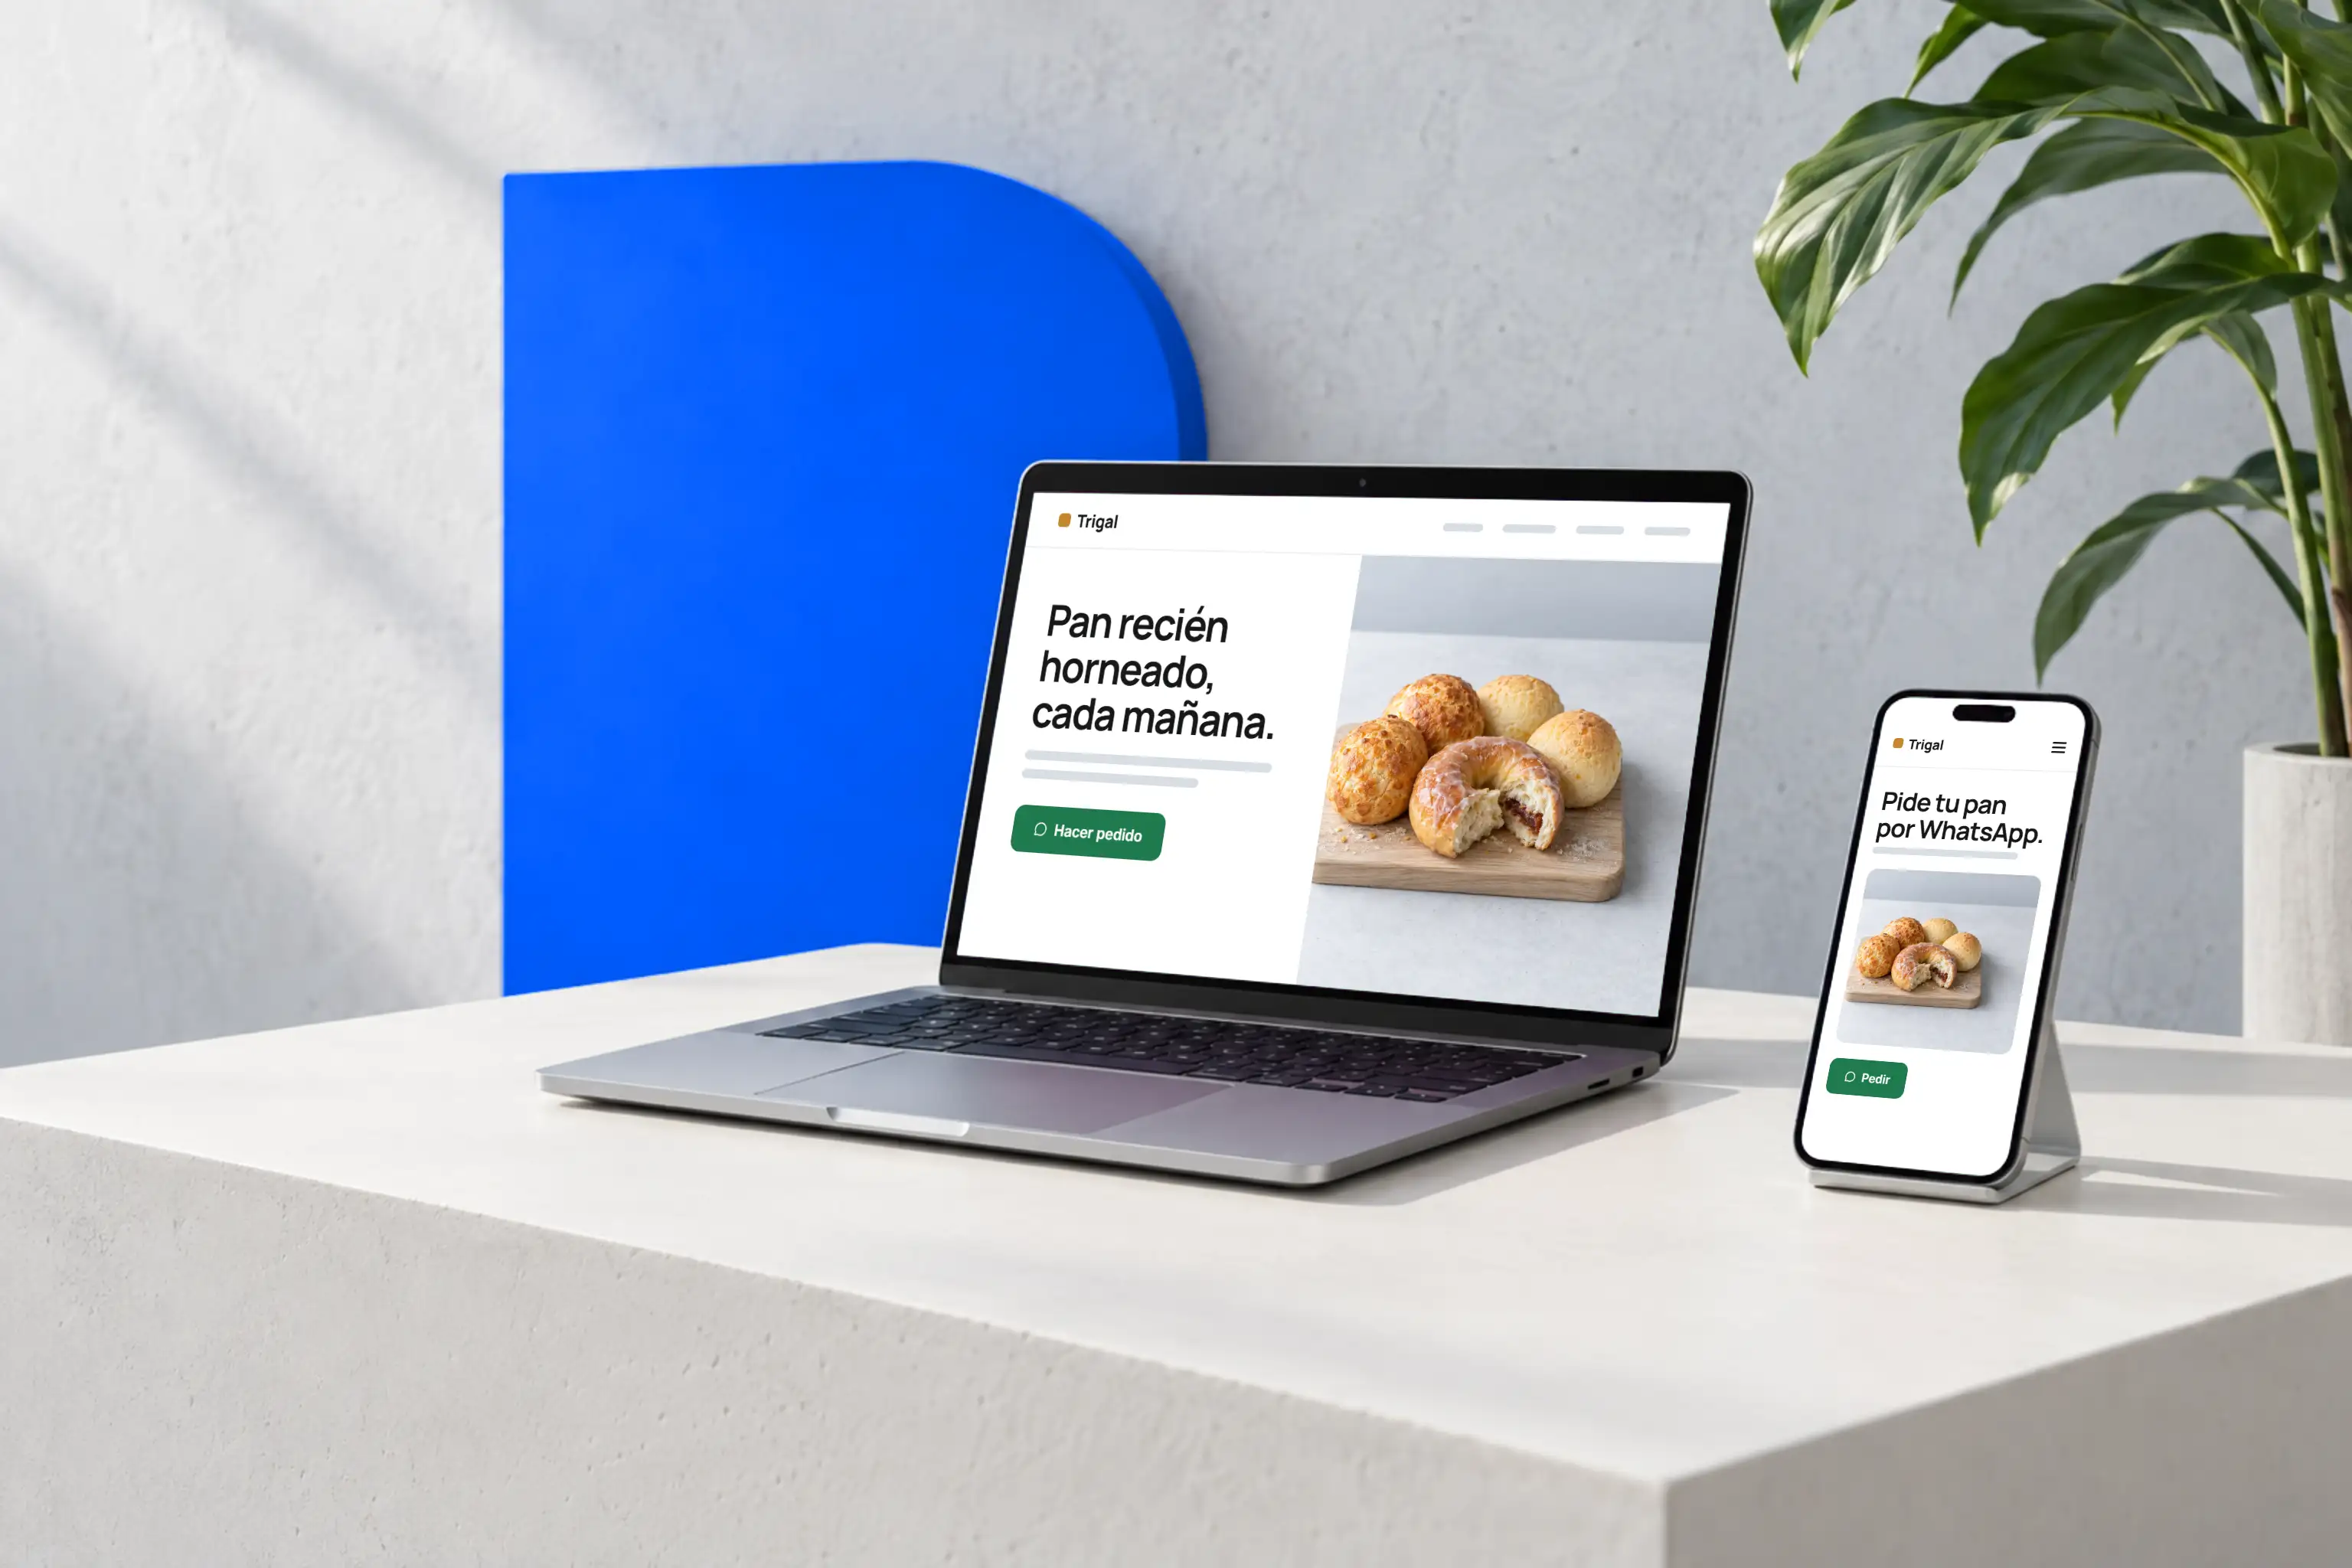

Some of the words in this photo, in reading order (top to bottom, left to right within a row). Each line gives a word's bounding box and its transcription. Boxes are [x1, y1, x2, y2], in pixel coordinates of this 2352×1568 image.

[1077, 514, 1119, 533] Trigal
[1047, 604, 1112, 639] Pan
[1119, 605, 1228, 643] recién
[1039, 649, 1214, 695] horneado,
[1032, 697, 1116, 732] cada
[1122, 699, 1273, 740] mañana.
[1908, 739, 1945, 753] Trigal
[1881, 791, 1931, 812] Pide
[1936, 794, 1960, 814] tu
[1962, 799, 2007, 820] pan
[1054, 824, 1094, 839] Hacer
[1096, 828, 1143, 843] pedido
[1875, 822, 1916, 843] por
[1919, 819, 2043, 849] WhatsApp.
[1861, 1073, 1891, 1085] Pedir
